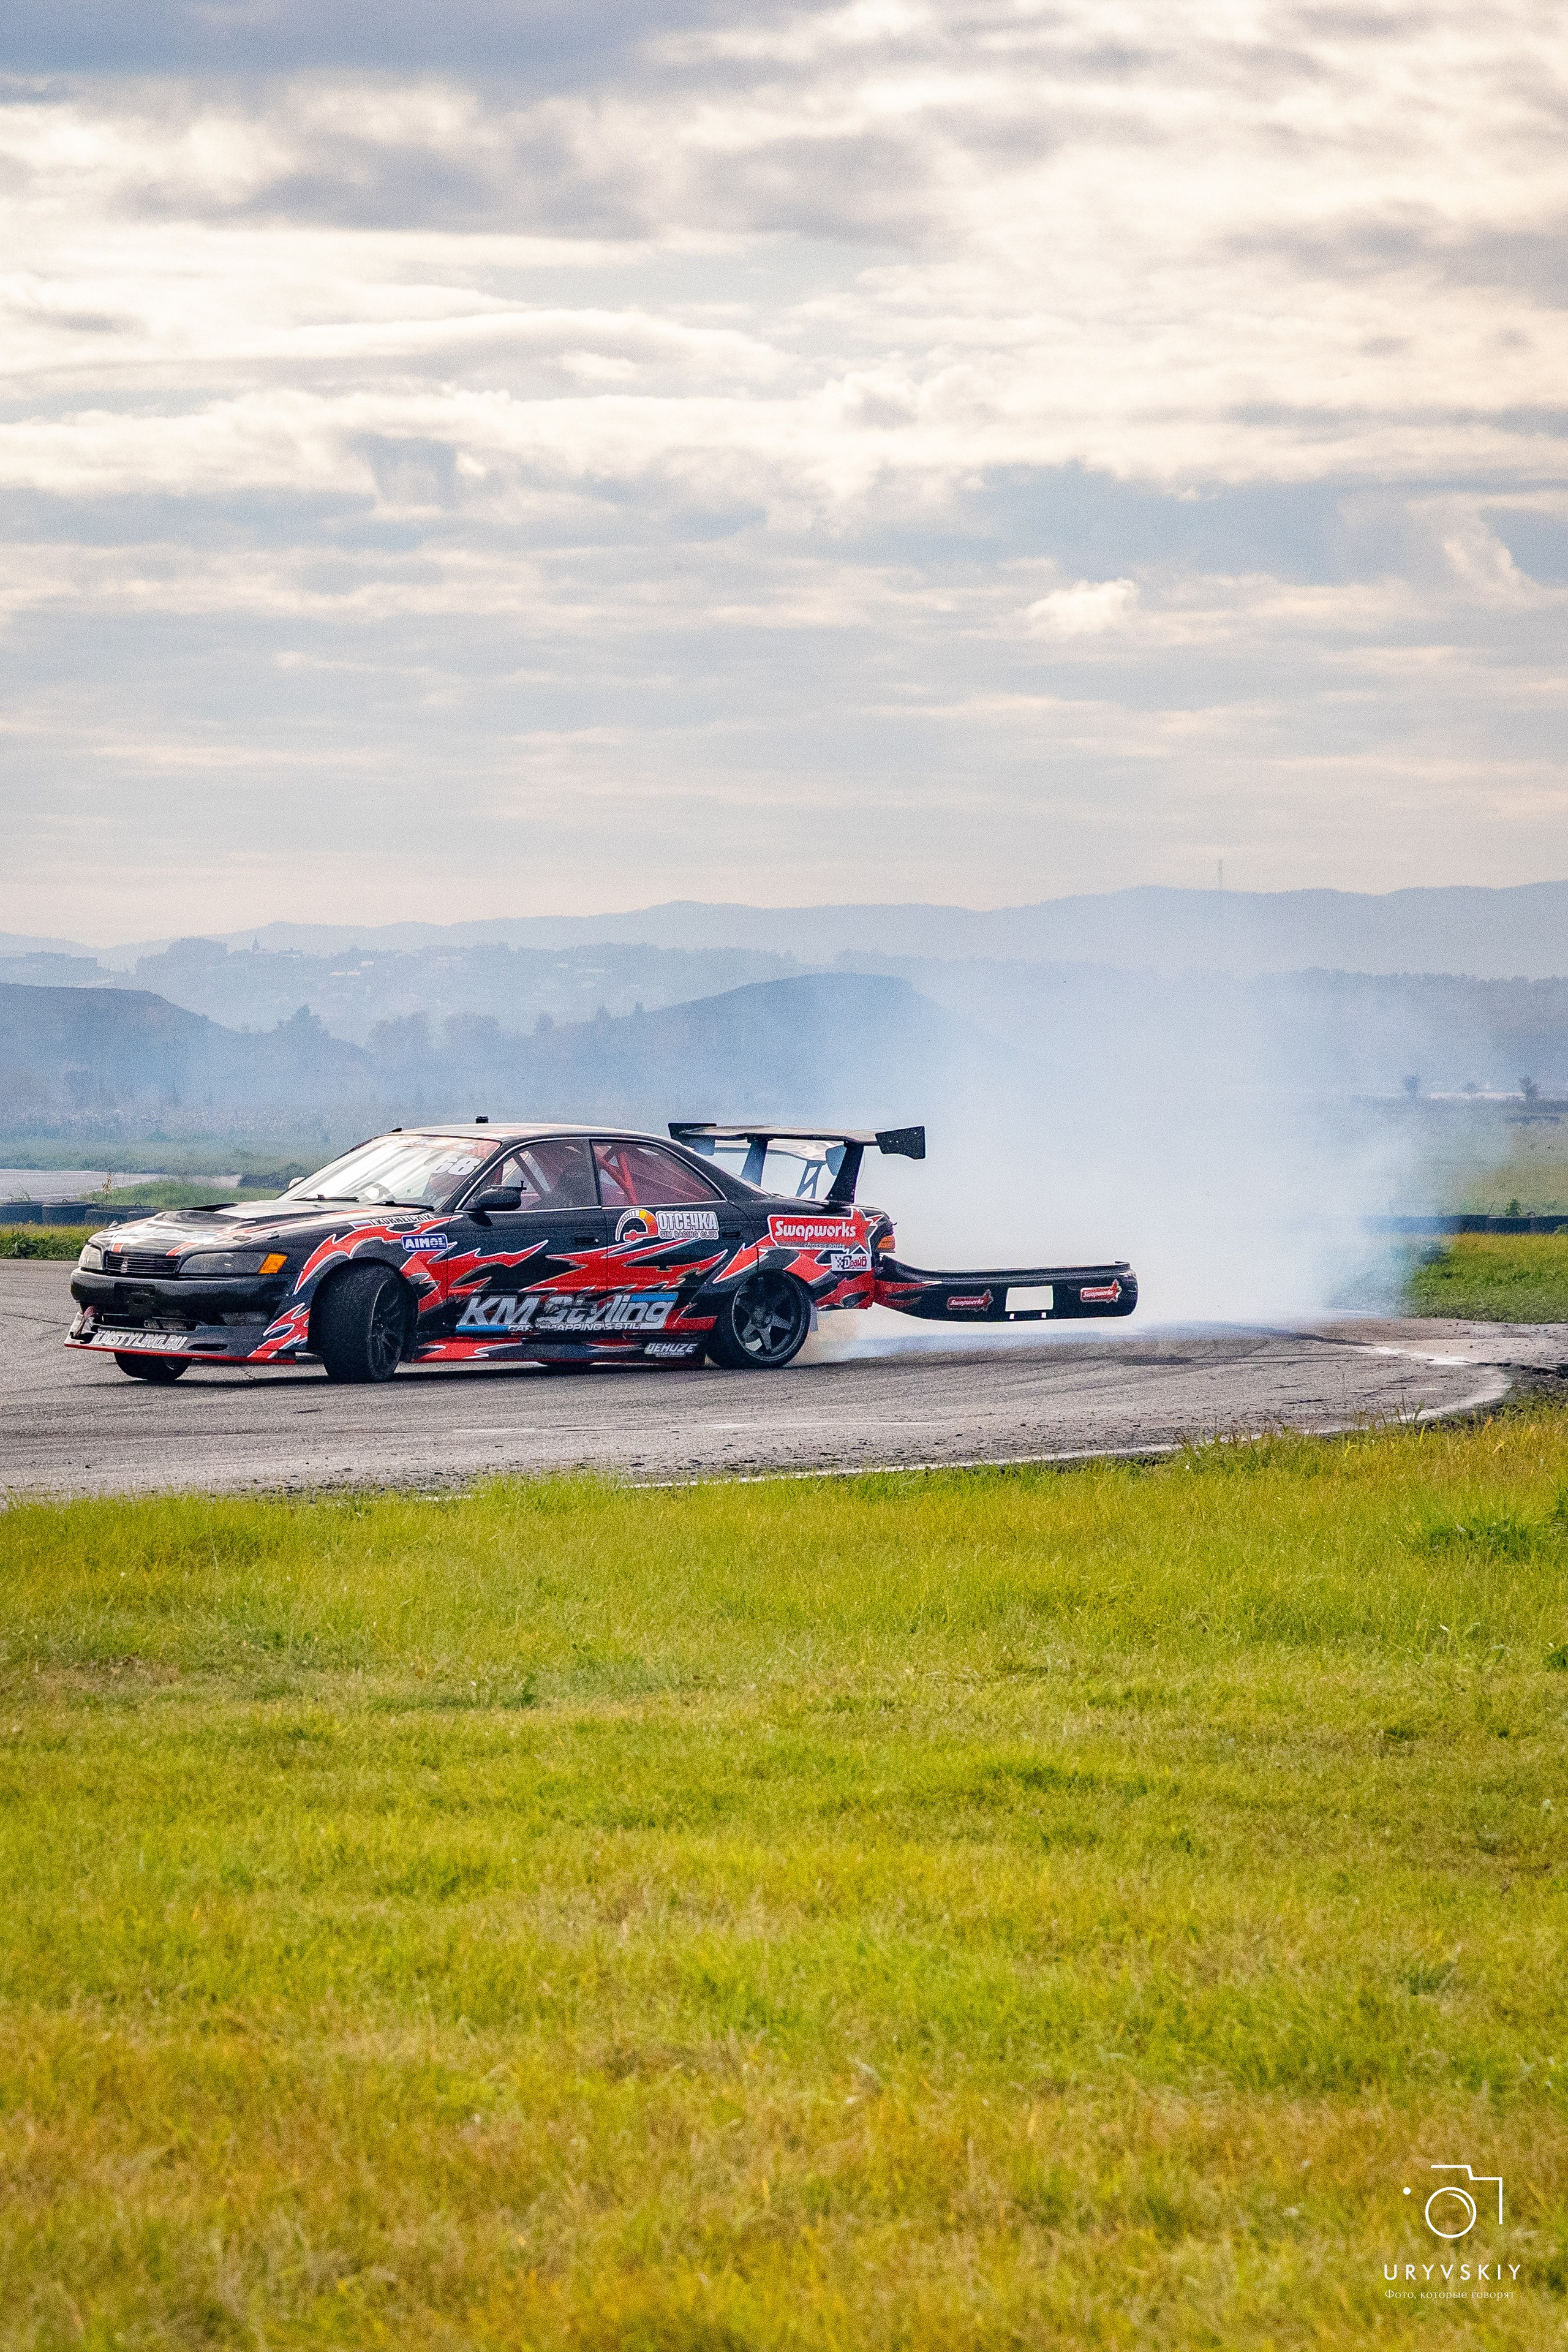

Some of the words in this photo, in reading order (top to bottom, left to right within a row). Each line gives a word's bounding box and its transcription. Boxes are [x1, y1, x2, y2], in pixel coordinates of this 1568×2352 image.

[429, 1157, 481, 1175] 68
[658, 1212, 718, 1231] ОТСЕЧКА
[775, 1221, 856, 1241] Swapworks
[405, 1237, 446, 1249] AIMOL
[459, 1297, 540, 1325] KM
[535, 1294, 674, 1330] Styling
[89, 1330, 188, 1351] KMSTYLING.RU
